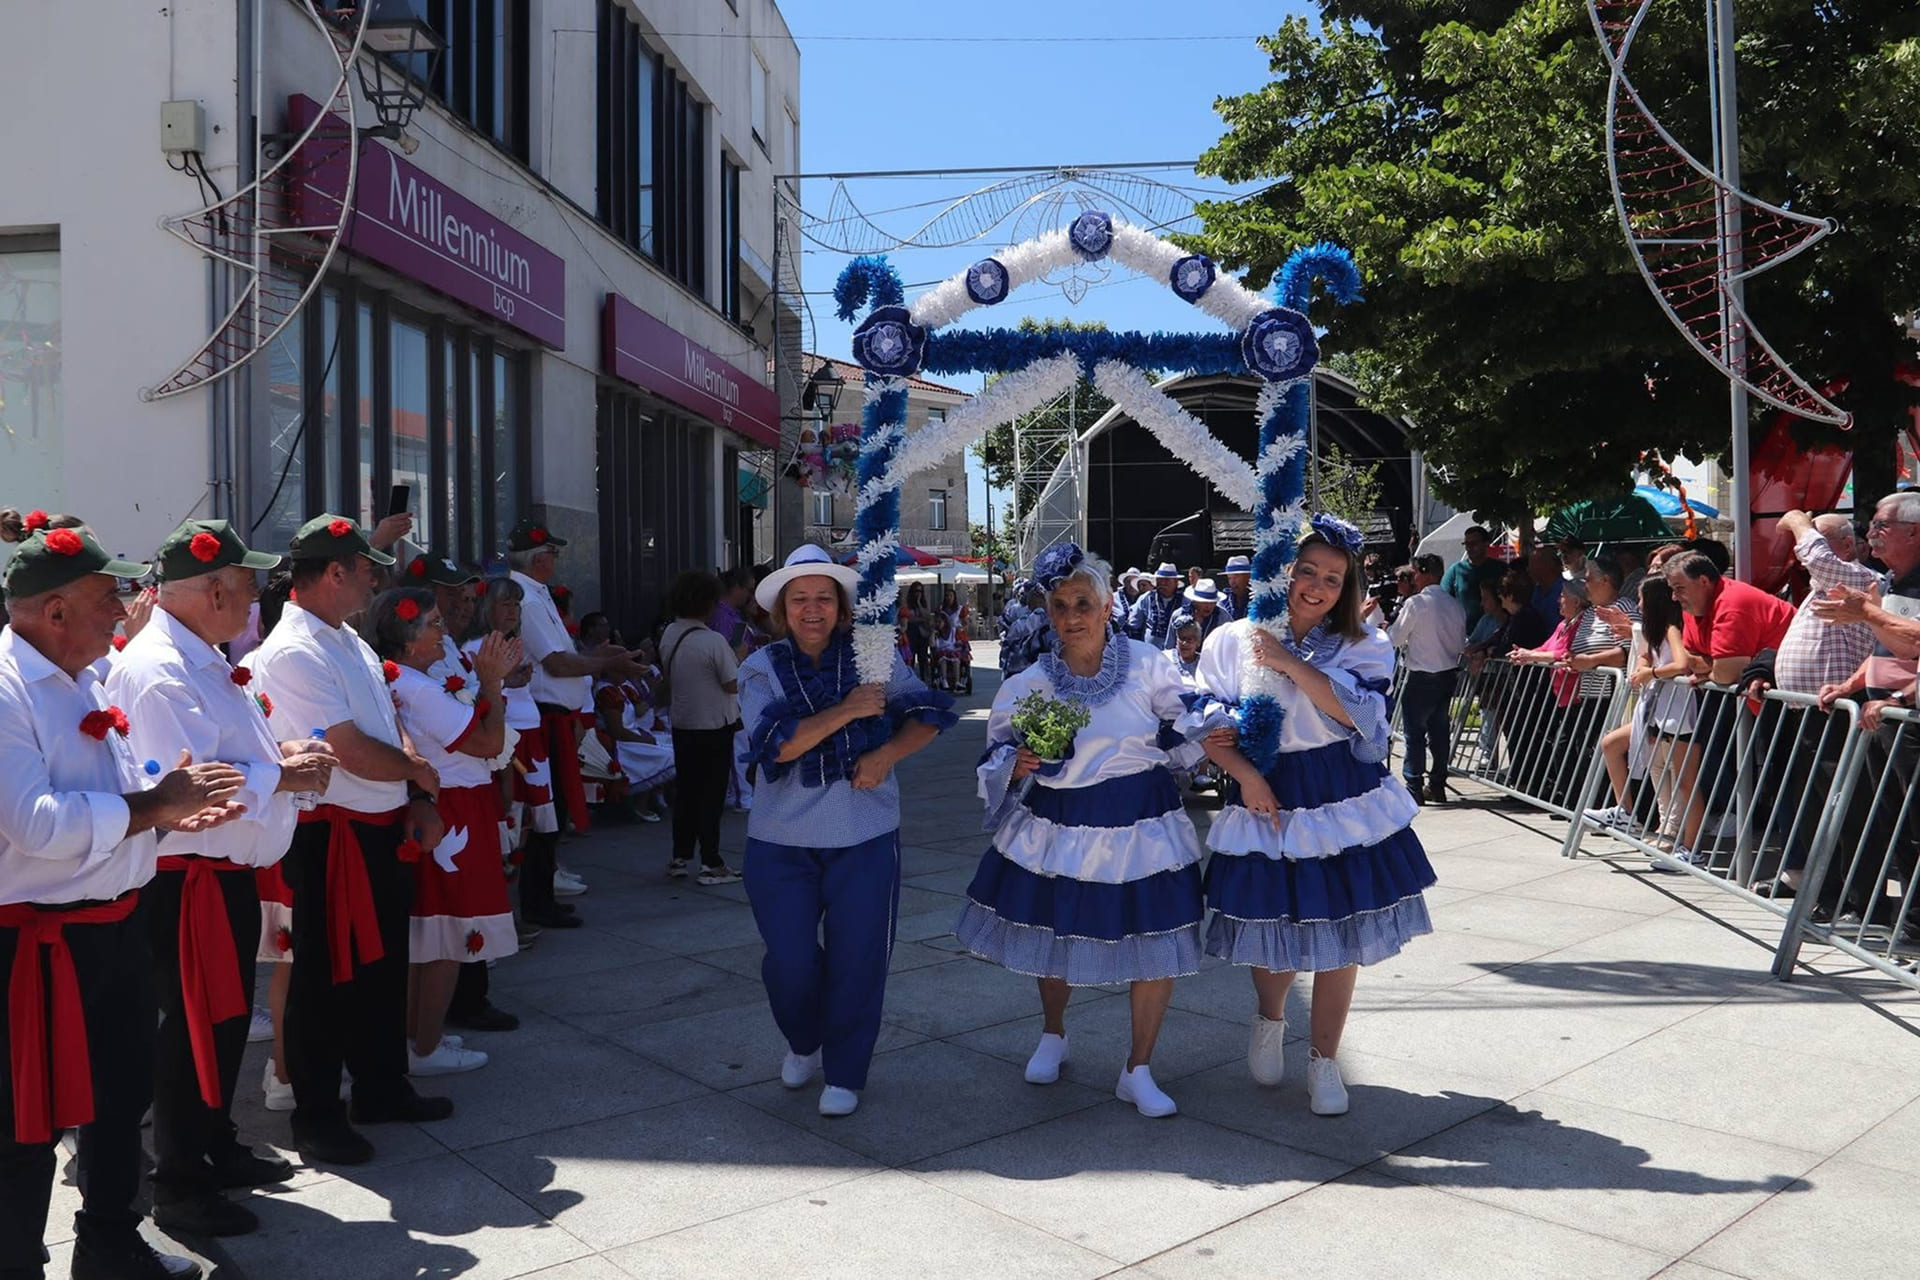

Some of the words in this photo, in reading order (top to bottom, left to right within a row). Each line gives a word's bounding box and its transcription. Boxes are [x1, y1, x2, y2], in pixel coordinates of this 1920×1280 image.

[387, 150, 531, 294] Millennium
[493, 284, 516, 321] bcp
[683, 338, 740, 406] Millennium
